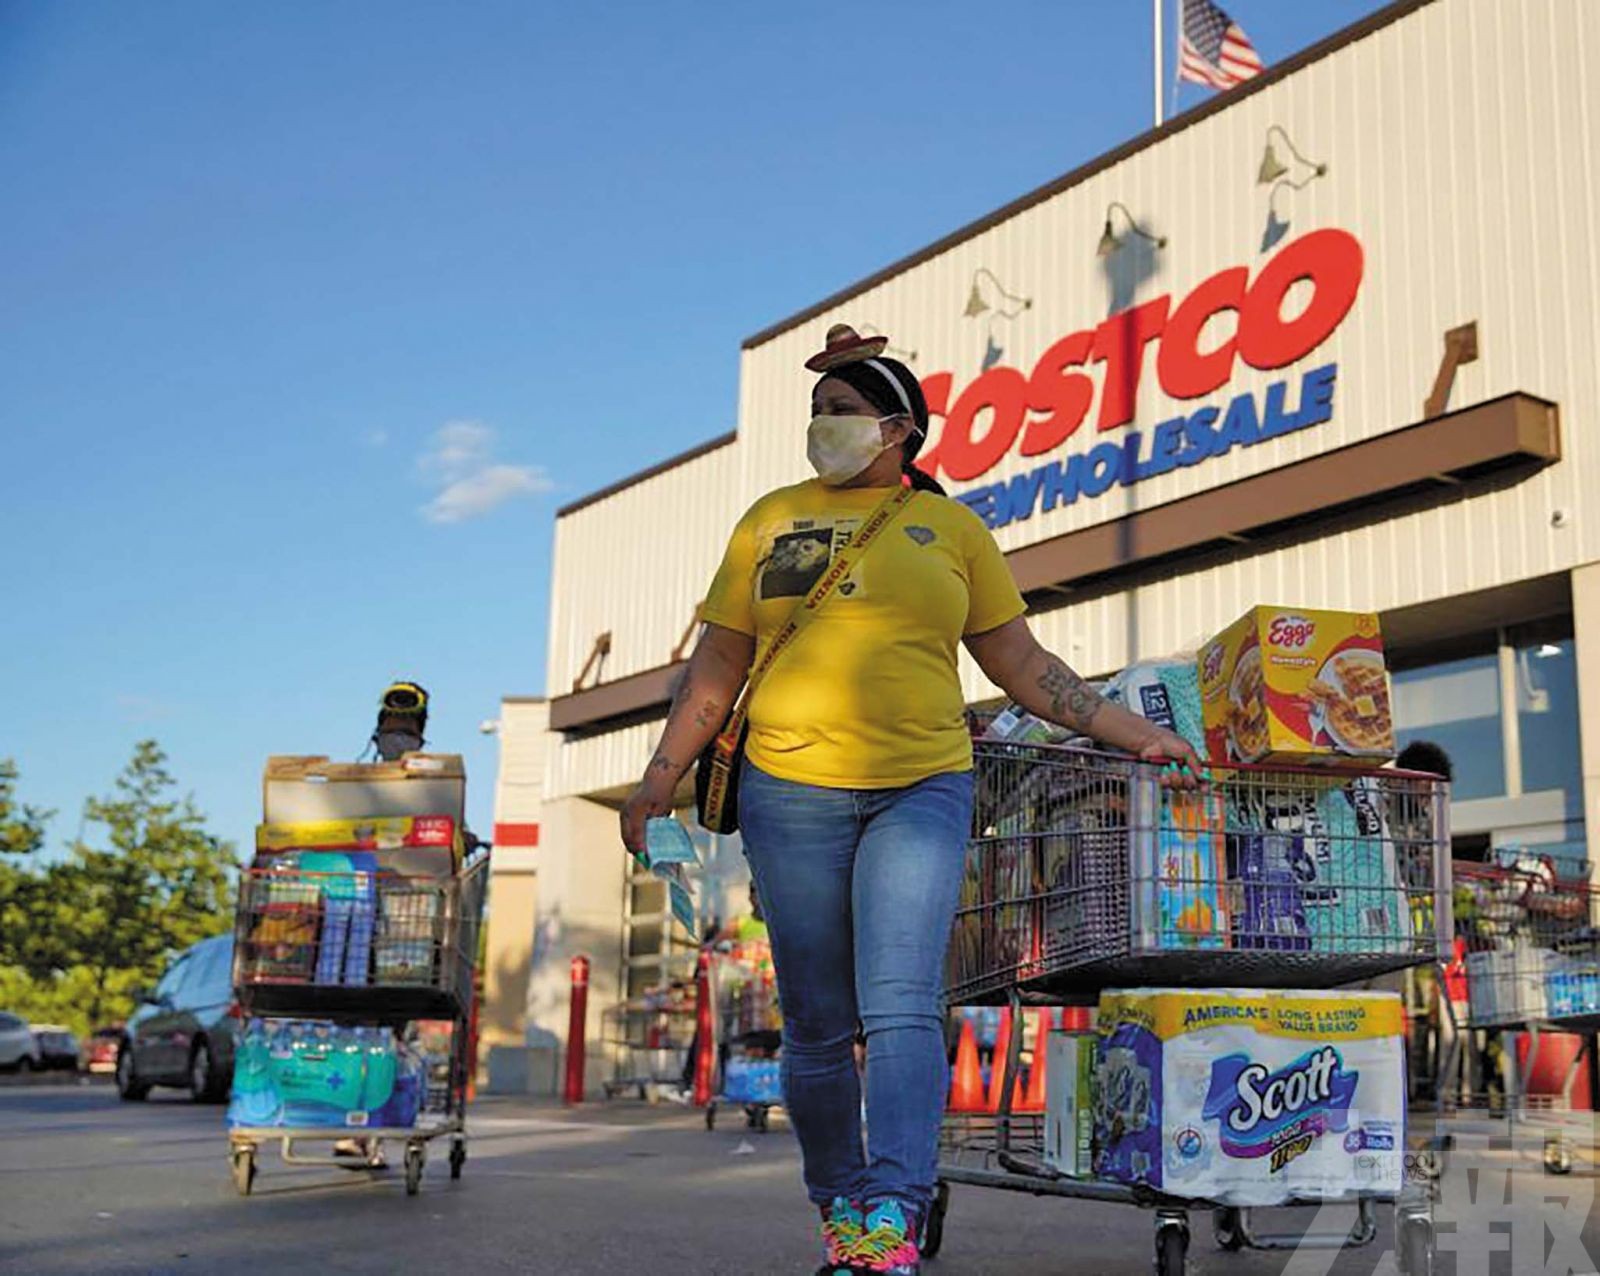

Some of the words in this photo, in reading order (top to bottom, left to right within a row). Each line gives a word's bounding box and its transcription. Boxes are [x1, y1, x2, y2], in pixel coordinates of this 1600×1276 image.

[989, 363, 1337, 529] WHOLESALE
[853, 509, 889, 549] HONDA
[806, 559, 849, 609] HONDA
[1268, 617, 1316, 648] Eggo
[1184, 1006, 1269, 1027] AMERICA'S
[1277, 1009, 1312, 1021] LONG
[1316, 1007, 1366, 1021] LASTING
[1278, 1020, 1314, 1033] VALUE
[1229, 1046, 1337, 1131] Scott
